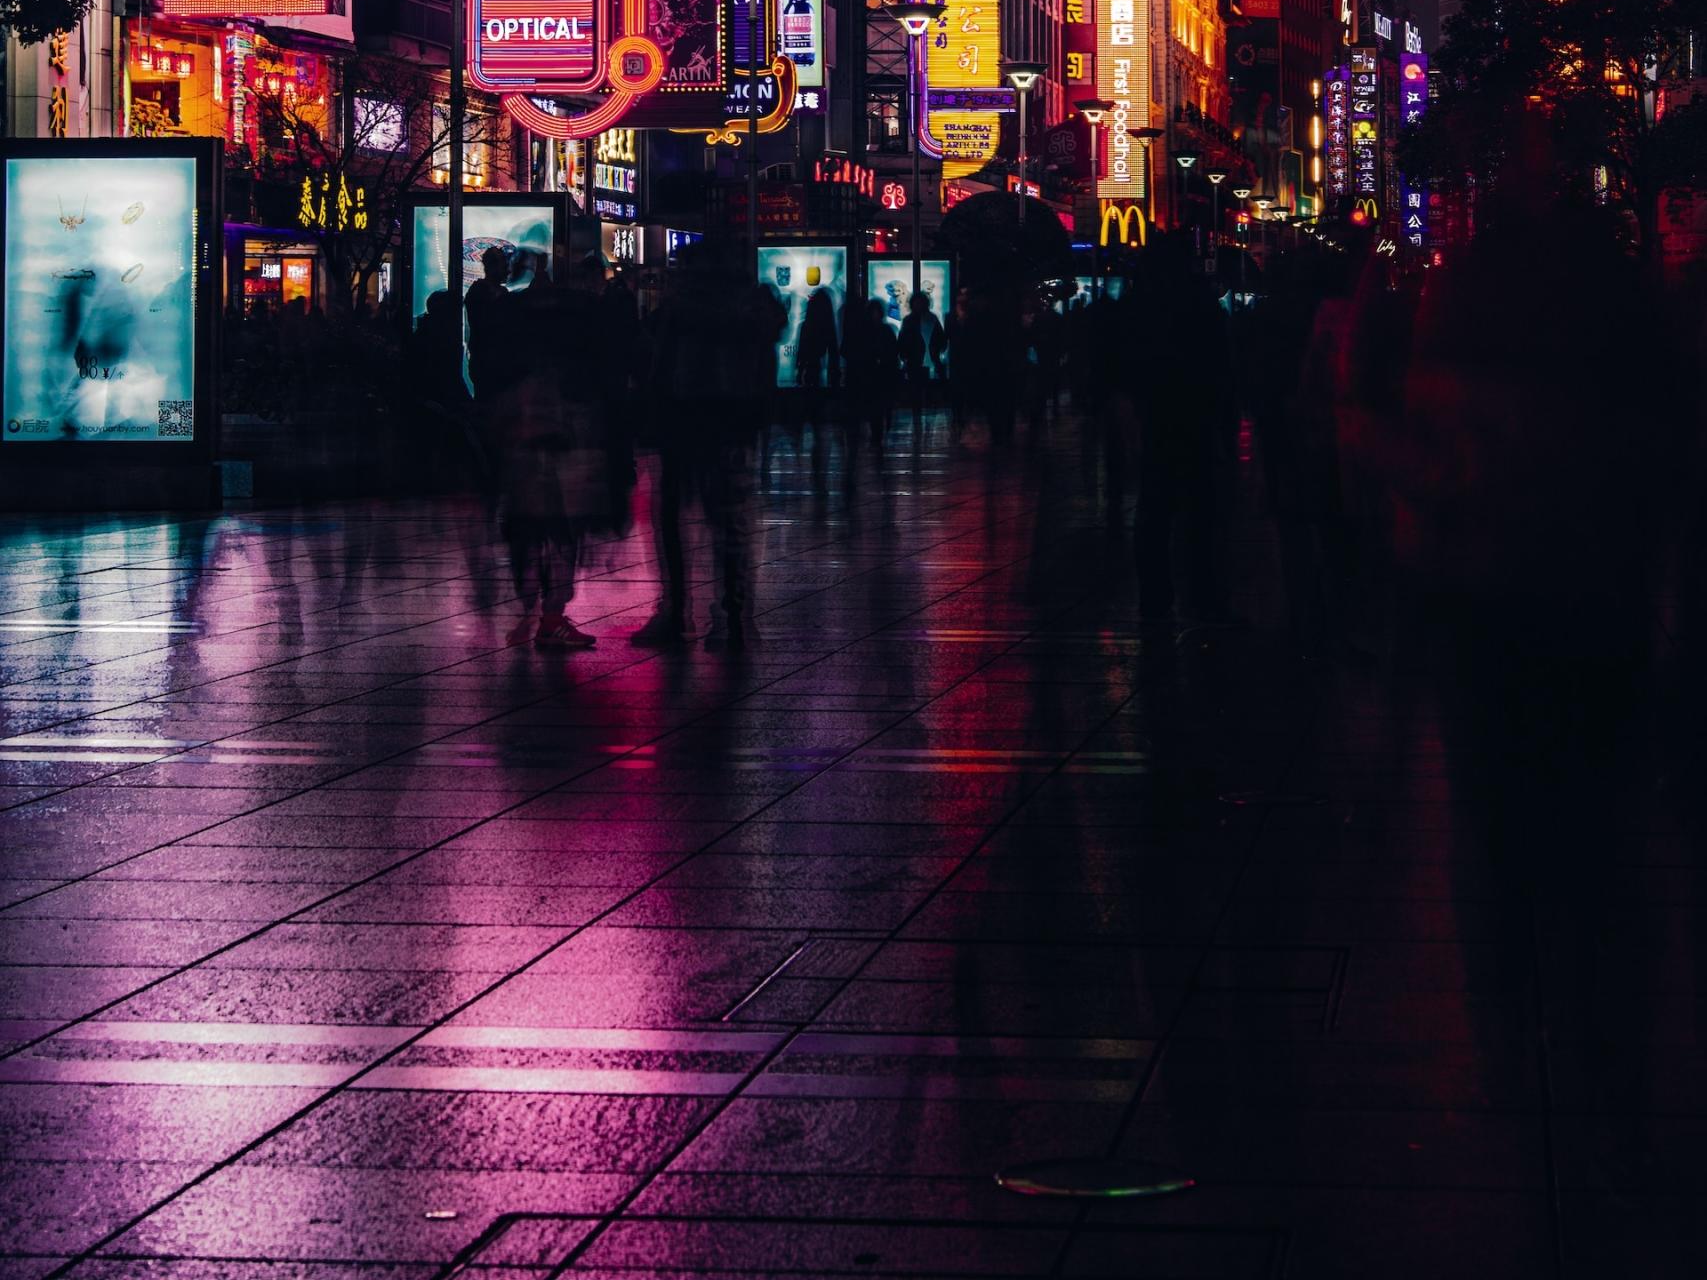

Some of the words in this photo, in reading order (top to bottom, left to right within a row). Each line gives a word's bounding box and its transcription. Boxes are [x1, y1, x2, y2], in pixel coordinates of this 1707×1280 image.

[486, 16, 586, 43] OPTICAL
[662, 67, 712, 81] ARTIN
[1114, 59, 1131, 95] First
[944, 124, 992, 132] SHANGHAI
[1114, 100, 1131, 182] Foodhall
[22, 419, 49, 434] 后院
